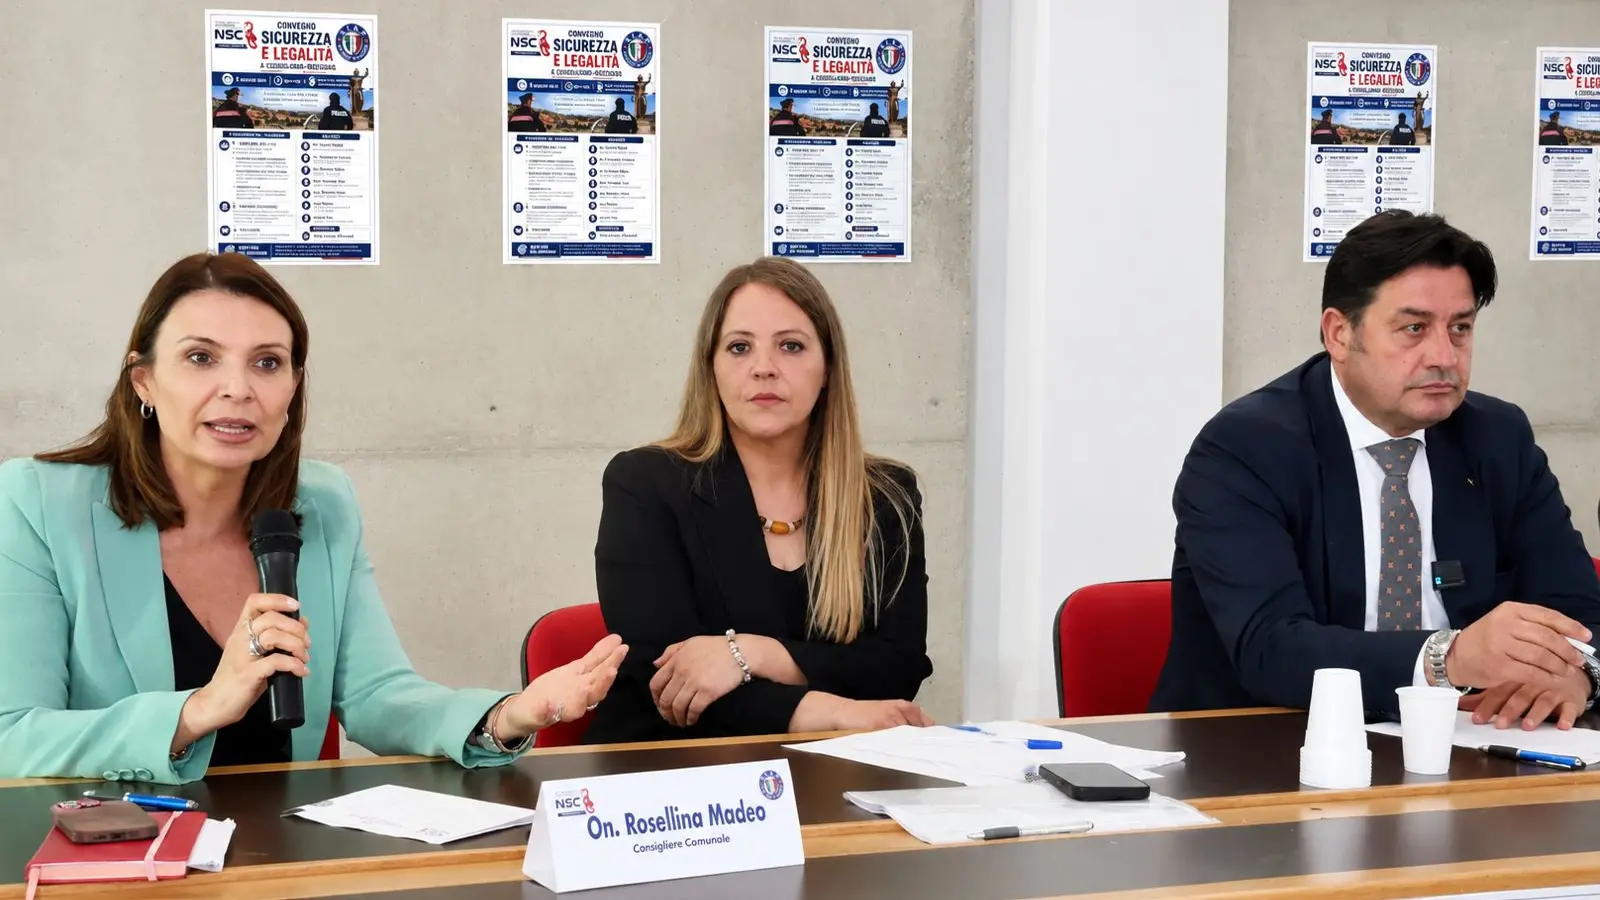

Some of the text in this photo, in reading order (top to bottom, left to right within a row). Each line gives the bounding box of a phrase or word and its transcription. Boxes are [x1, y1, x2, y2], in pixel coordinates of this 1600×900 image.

[214, 29, 244, 40] NSC
[261, 31, 332, 46] SICUREZZA
[511, 37, 538, 48] NSC
[553, 39, 618, 53] SICUREZZA
[772, 44, 798, 54] NSC
[262, 46, 334, 61] E LEGALITÀ
[813, 46, 872, 59] SICUREZZA
[554, 54, 620, 68] E LEGALITÀ
[813, 60, 874, 74] E LEGALITÀ
[1315, 59, 1336, 68] NSC
[1350, 60, 1402, 72] SICUREZZA
[1544, 63, 1564, 72] NSC
[1576, 64, 1600, 75] SICU
[1350, 73, 1403, 86] E LEGALITÀ
[1576, 76, 1582, 88] E
[555, 796, 581, 809] NSC
[587, 799, 766, 840] On. Rosellina Madeo
[633, 838, 682, 854] Consigliere
